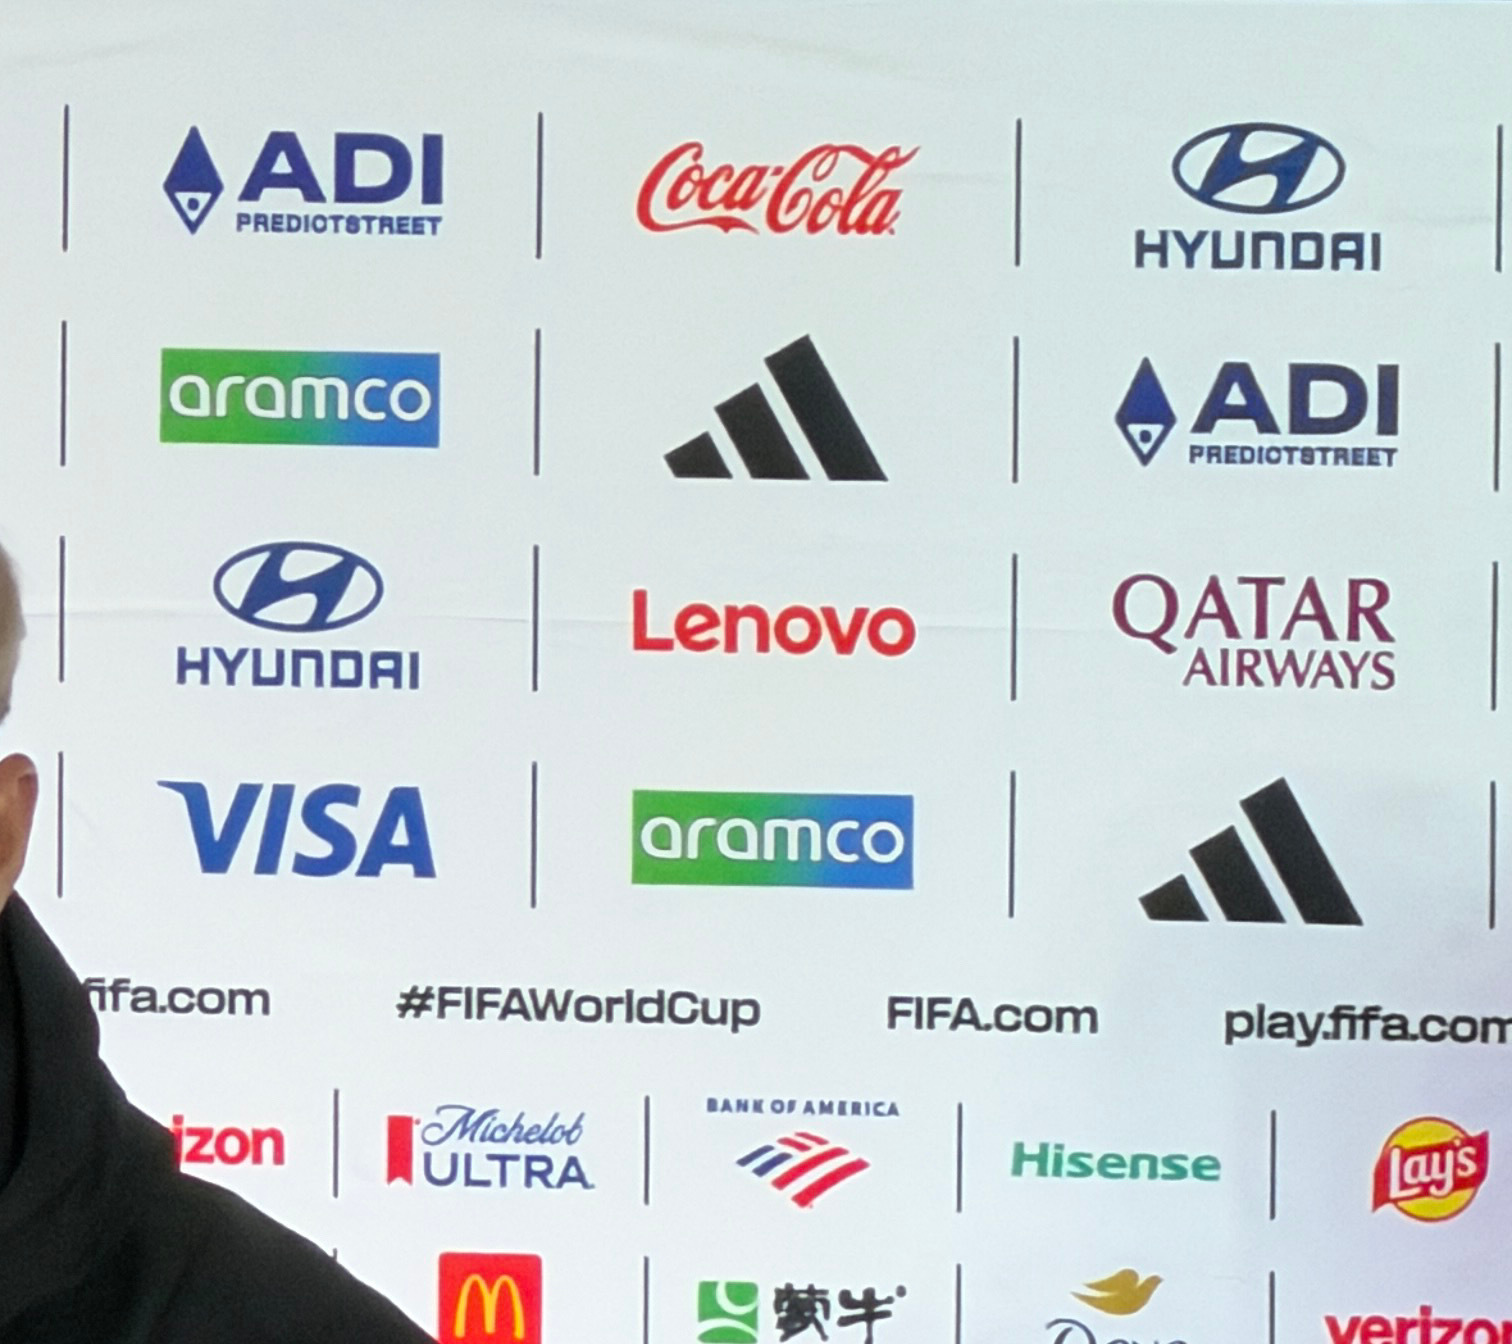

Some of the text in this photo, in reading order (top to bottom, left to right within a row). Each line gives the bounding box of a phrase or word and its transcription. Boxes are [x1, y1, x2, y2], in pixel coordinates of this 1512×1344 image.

[237, 131, 444, 205] ADI
[636, 141, 921, 236] Coca-Cola
[1135, 230, 1382, 272] HYUNDAI
[168, 374, 432, 422] aramco
[1190, 362, 1400, 436] ADI
[633, 589, 916, 657] Lenovo
[1112, 573, 1396, 655] QATAR
[176, 646, 420, 690] HYUNDAI
[1182, 648, 1397, 690] AIRWAYS
[157, 781, 437, 878] VISA
[640, 816, 904, 864] aramco
[397, 986, 761, 1033] #FIFAWorldCup
[888, 996, 1099, 1034] FIFA.com
[421, 1105, 586, 1146] Michelob
[706, 1097, 900, 1117] BANK OF AMERICA
[423, 1152, 589, 1189] ULTRA
[1011, 1142, 1222, 1182] Hisense
[1390, 1141, 1478, 1199] Lay's
